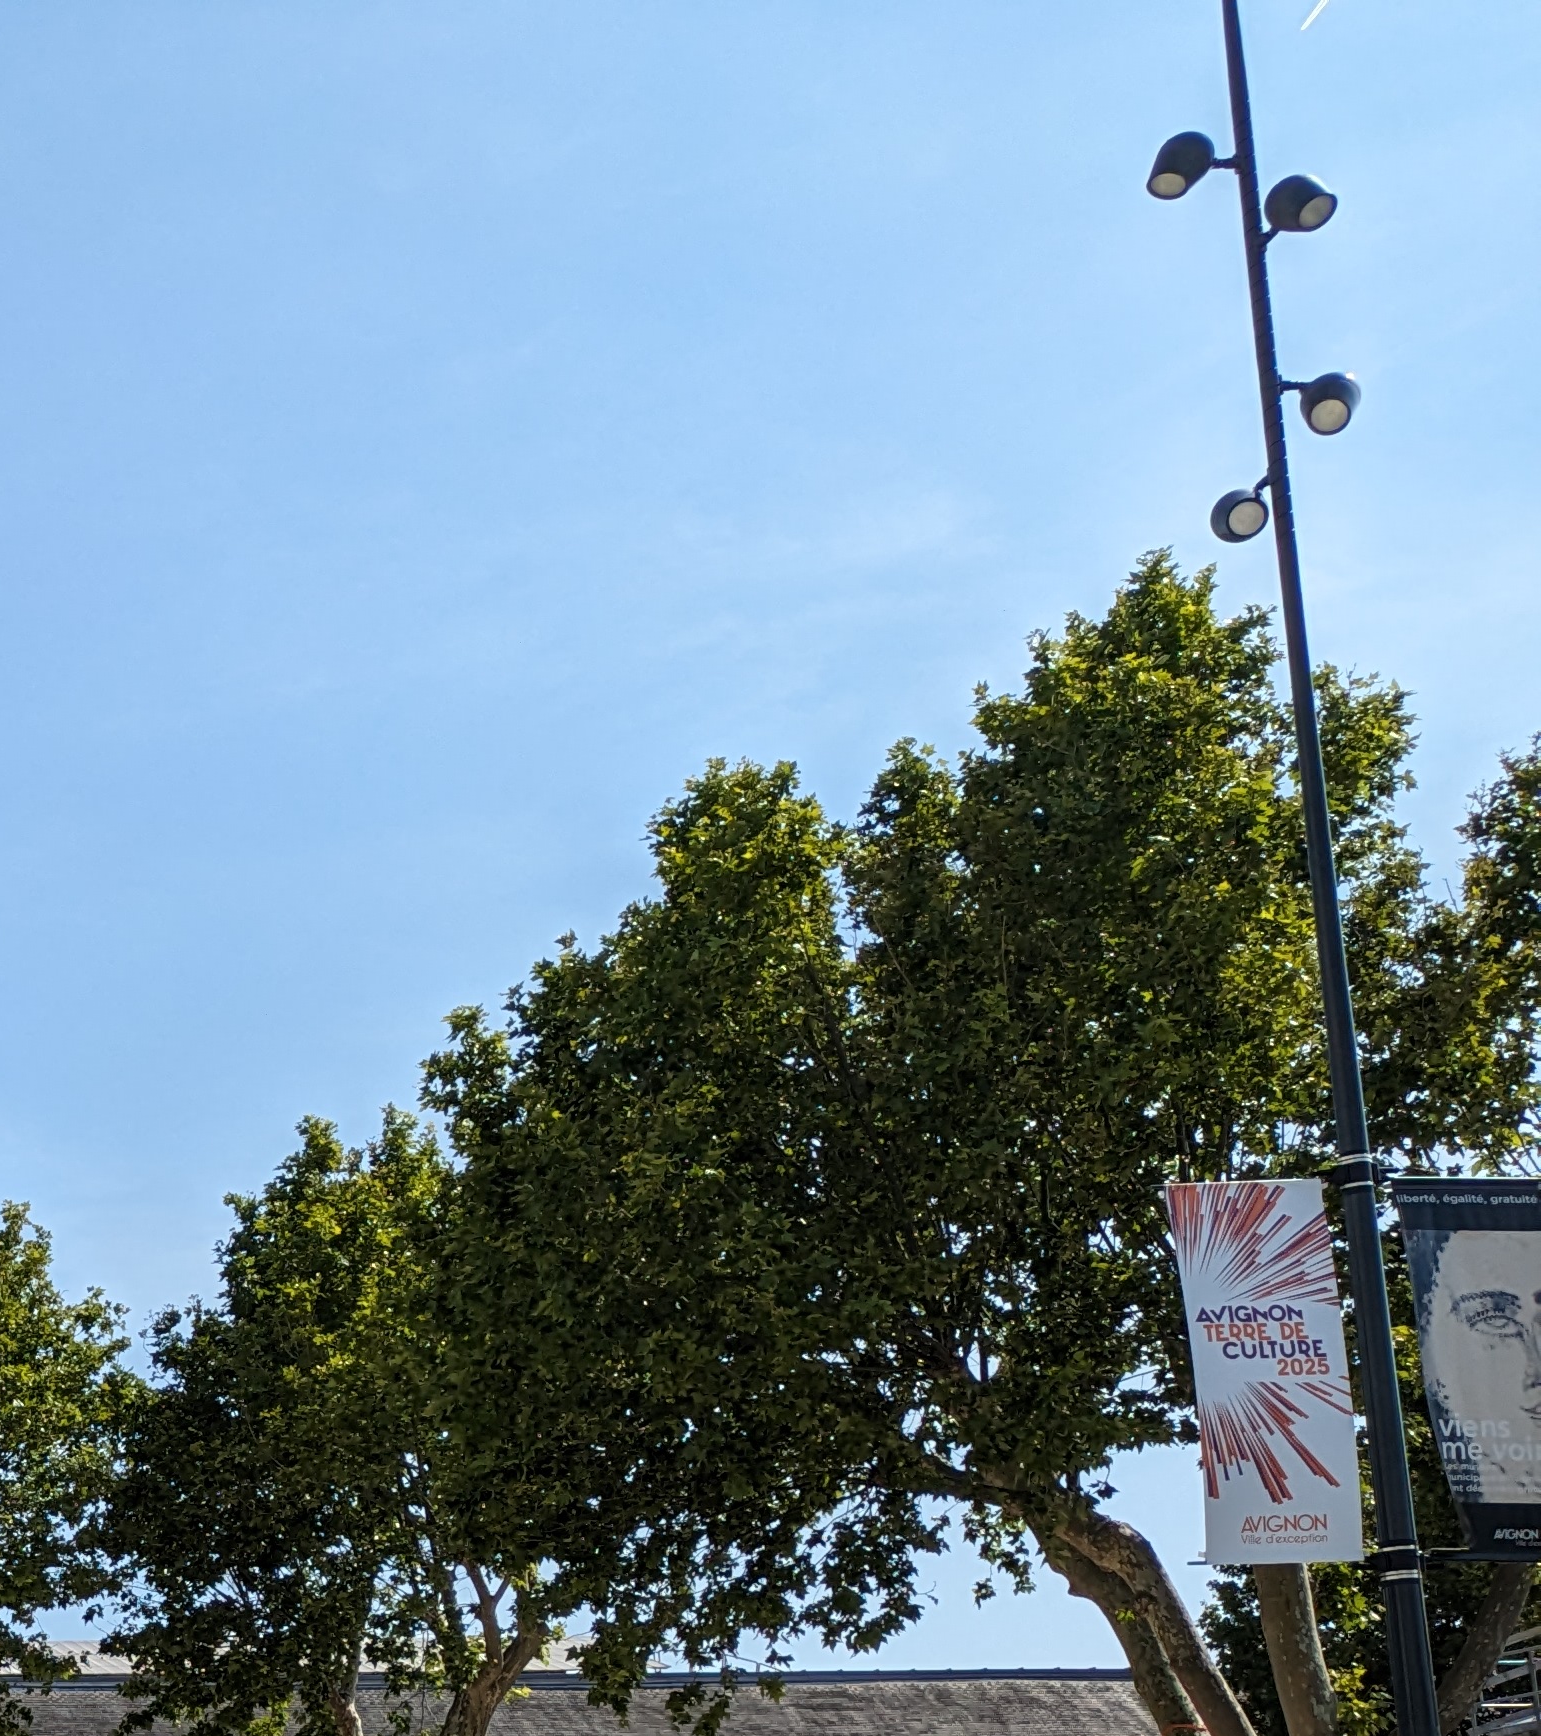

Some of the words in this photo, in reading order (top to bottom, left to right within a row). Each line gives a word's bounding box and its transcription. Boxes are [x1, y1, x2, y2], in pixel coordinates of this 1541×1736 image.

[1396, 1194, 1440, 1204] liberté,
[1442, 1194, 1488, 1205] égalité,
[1490, 1194, 1538, 1205] gratuité
[1195, 1304, 1304, 1324] AVIGNON
[1203, 1323, 1272, 1342] TERRE
[1279, 1322, 1309, 1341] DE
[1222, 1339, 1327, 1360] CULTURE
[1277, 1357, 1330, 1376] 2025
[1438, 1413, 1511, 1439] viens
[1442, 1441, 1483, 1460] me
[1240, 1513, 1328, 1534] AVIGNON
[1241, 1534, 1261, 1545] Ville
[1265, 1533, 1328, 1545] d'exception
[1494, 1528, 1539, 1540] AVIGNON
